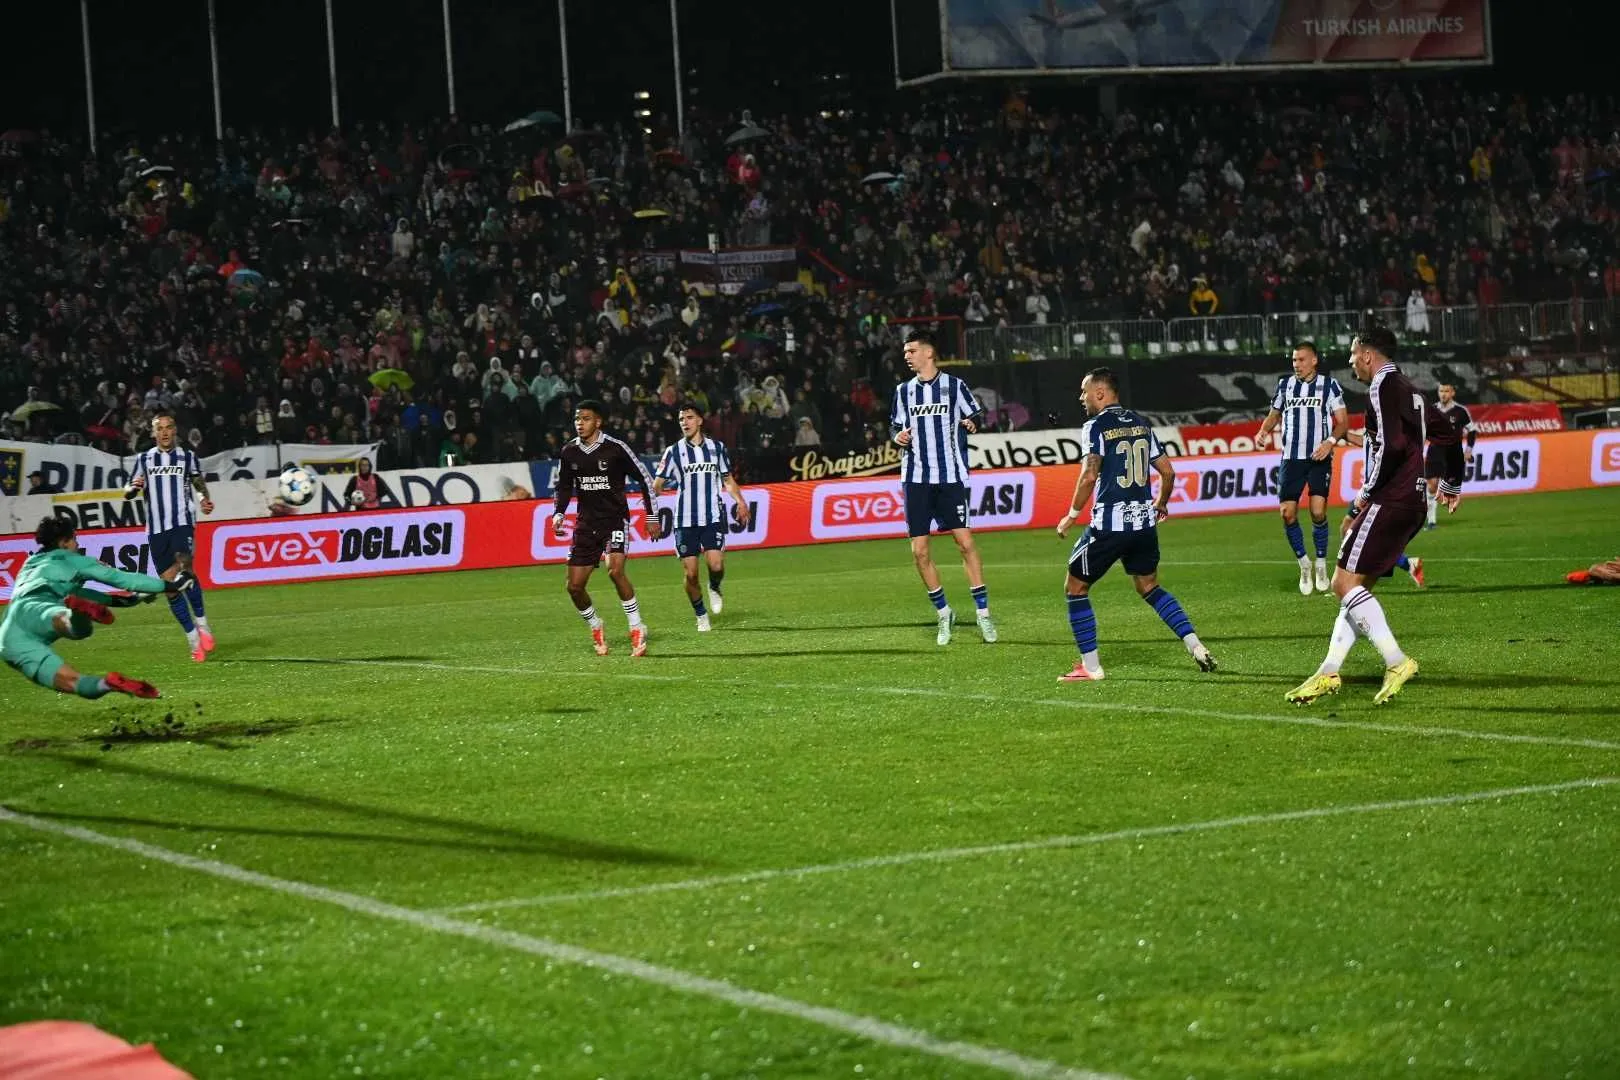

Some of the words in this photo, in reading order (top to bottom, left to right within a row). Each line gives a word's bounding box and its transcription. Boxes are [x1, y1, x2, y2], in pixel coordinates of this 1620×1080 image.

[1303, 17, 1380, 37] TURKISH
[1386, 16, 1465, 35] AIRLINES
[1473, 421, 1502, 432] KISH
[1506, 419, 1561, 431] AIRLINES
[1116, 438, 1149, 489] 30
[338, 522, 453, 563] OGLASI
[611, 531, 625, 542] 19
